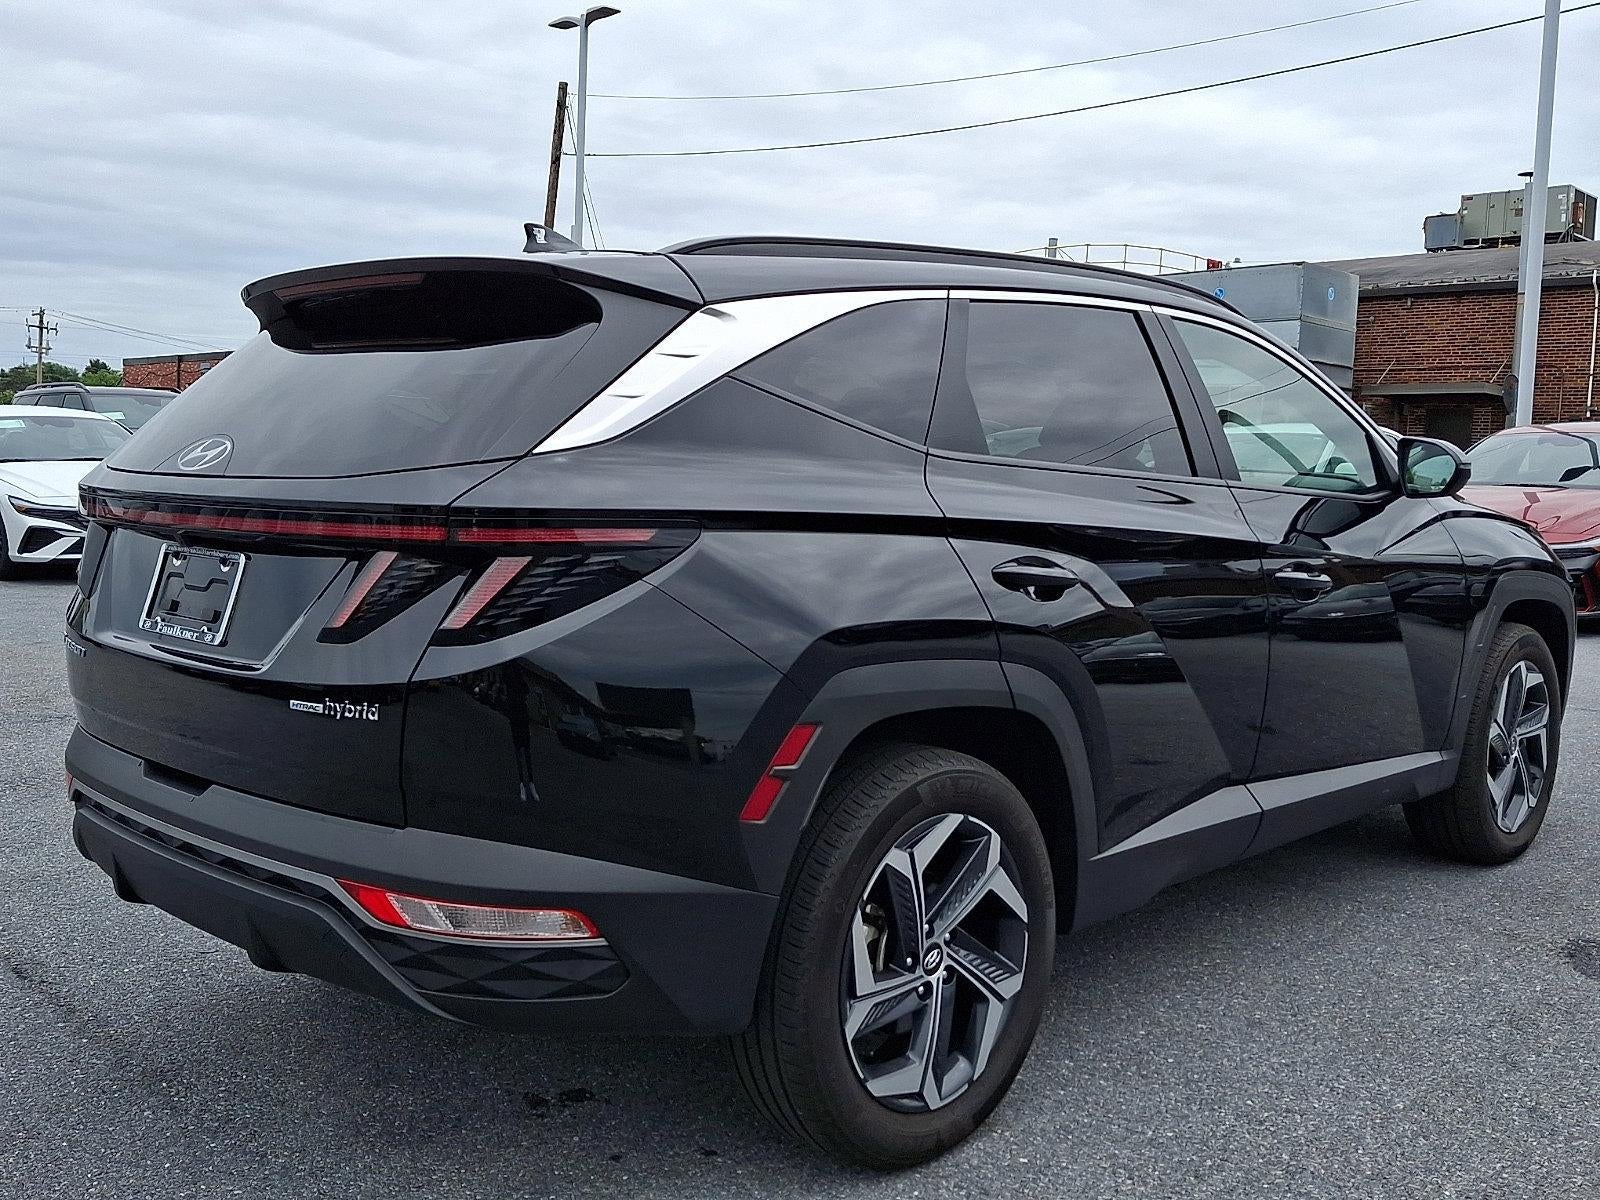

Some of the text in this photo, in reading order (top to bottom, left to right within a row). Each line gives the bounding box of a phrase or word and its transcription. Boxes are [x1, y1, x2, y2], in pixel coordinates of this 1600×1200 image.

[156, 624, 199, 640] Faulkner
[291, 698, 379, 720] HTRAC hybrid
